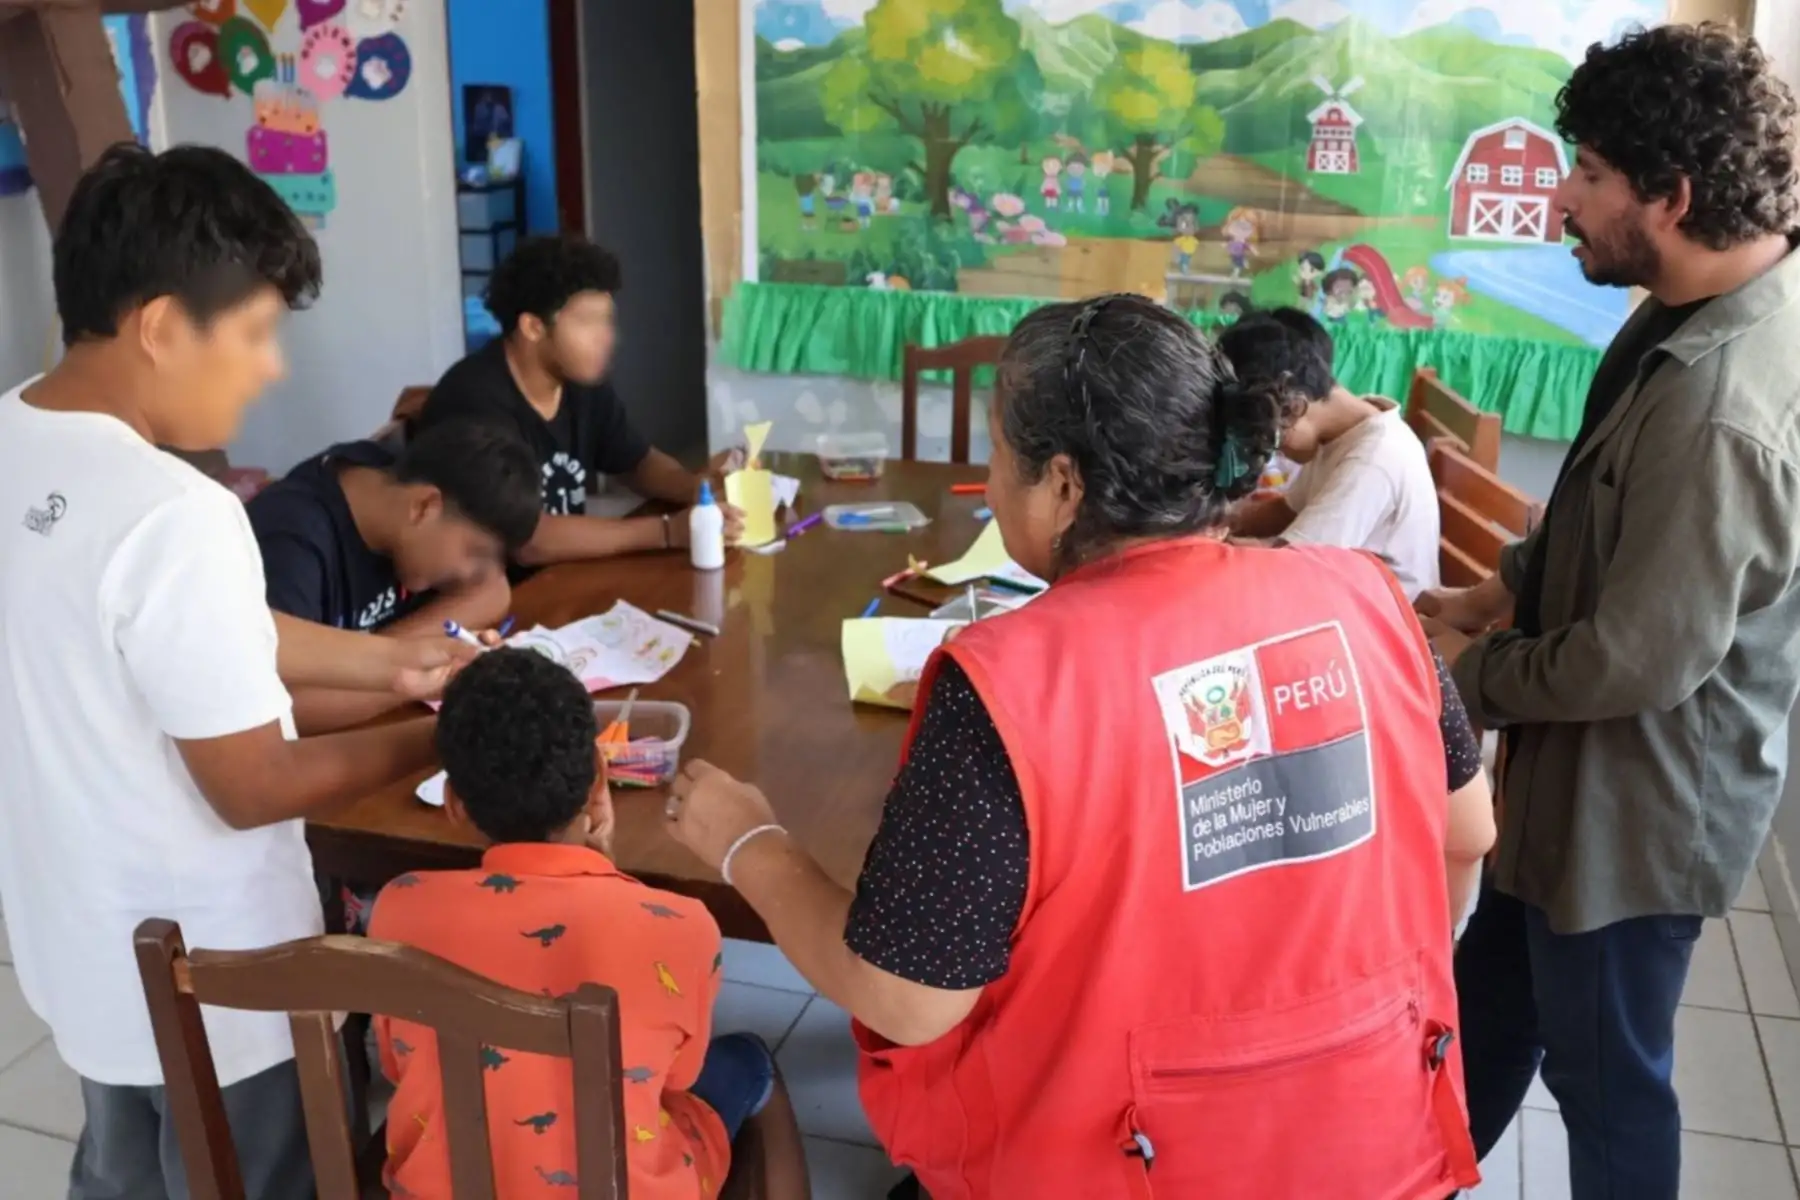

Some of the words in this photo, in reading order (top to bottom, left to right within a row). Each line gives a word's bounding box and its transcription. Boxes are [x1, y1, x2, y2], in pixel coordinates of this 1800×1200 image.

[1273, 659, 1347, 715] PERÚ
[1190, 777, 1262, 818] Ministerio
[1193, 819, 1212, 839] de
[1213, 812, 1228, 831] la
[1230, 798, 1273, 823] Mujer
[1275, 795, 1287, 817] y
[1193, 821, 1285, 862] Poblaciones
[1289, 797, 1370, 834] Vulnerables
